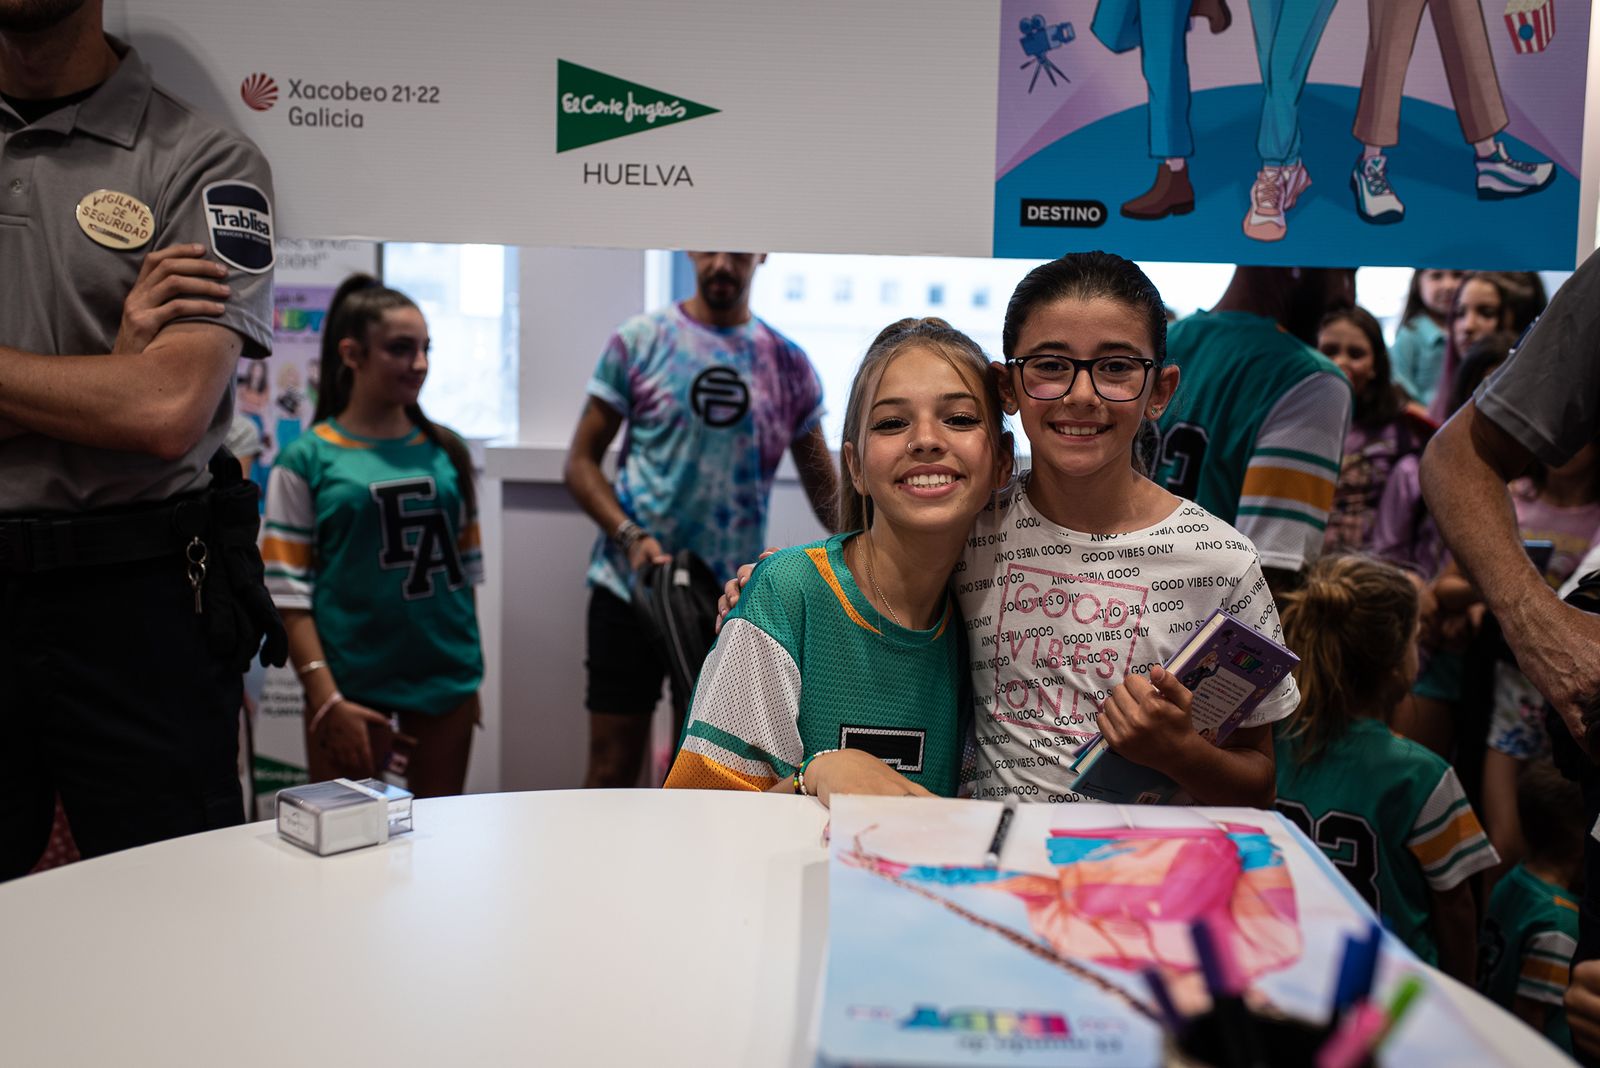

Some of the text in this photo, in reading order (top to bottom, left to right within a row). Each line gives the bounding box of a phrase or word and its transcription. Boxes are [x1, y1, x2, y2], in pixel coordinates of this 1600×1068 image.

[288, 79, 388, 101] Xacobeo
[562, 91, 687, 123] El Corte Inglés
[288, 106, 364, 129] Galicia
[583, 162, 694, 187] HUELVA
[92, 193, 150, 227] VIGILANTE
[112, 206, 128, 219] DE
[1027, 205, 1101, 222] DESTINO
[81, 206, 149, 240] SEGURIDAD
[208, 208, 271, 236] Trablisa
[1177, 523, 1209, 534] GOOD
[994, 544, 1072, 564] GOOD VIBES ONLY
[1081, 543, 1174, 563] GOOD VIBES ONLY
[1195, 540, 1222, 551] ONLY
[997, 572, 1025, 586] GOOD
[1107, 566, 1141, 579] GOOD
[975, 578, 996, 591] VIBES
[1151, 575, 1242, 591] GOOD VIBES ONLY
[1250, 576, 1266, 597] VIBE
[1015, 583, 1128, 629] GOOD
[1153, 599, 1184, 613] GOOD
[1025, 625, 1054, 639] GOOD
[1168, 621, 1193, 634] ONLY
[1063, 634, 1093, 646] GOOD
[1095, 629, 1122, 641] VIBES
[1007, 630, 1115, 680] VIBES
[1042, 675, 1067, 687] ONLY
[1005, 680, 1108, 722] ONLY
[1029, 738, 1053, 749] ONLY
[1055, 735, 1081, 747] VIBES
[1016, 757, 1036, 768] VIBES
[1037, 755, 1061, 766] ONLY
[1048, 793, 1081, 803] GOOD
[1274, 798, 1380, 916] 3
